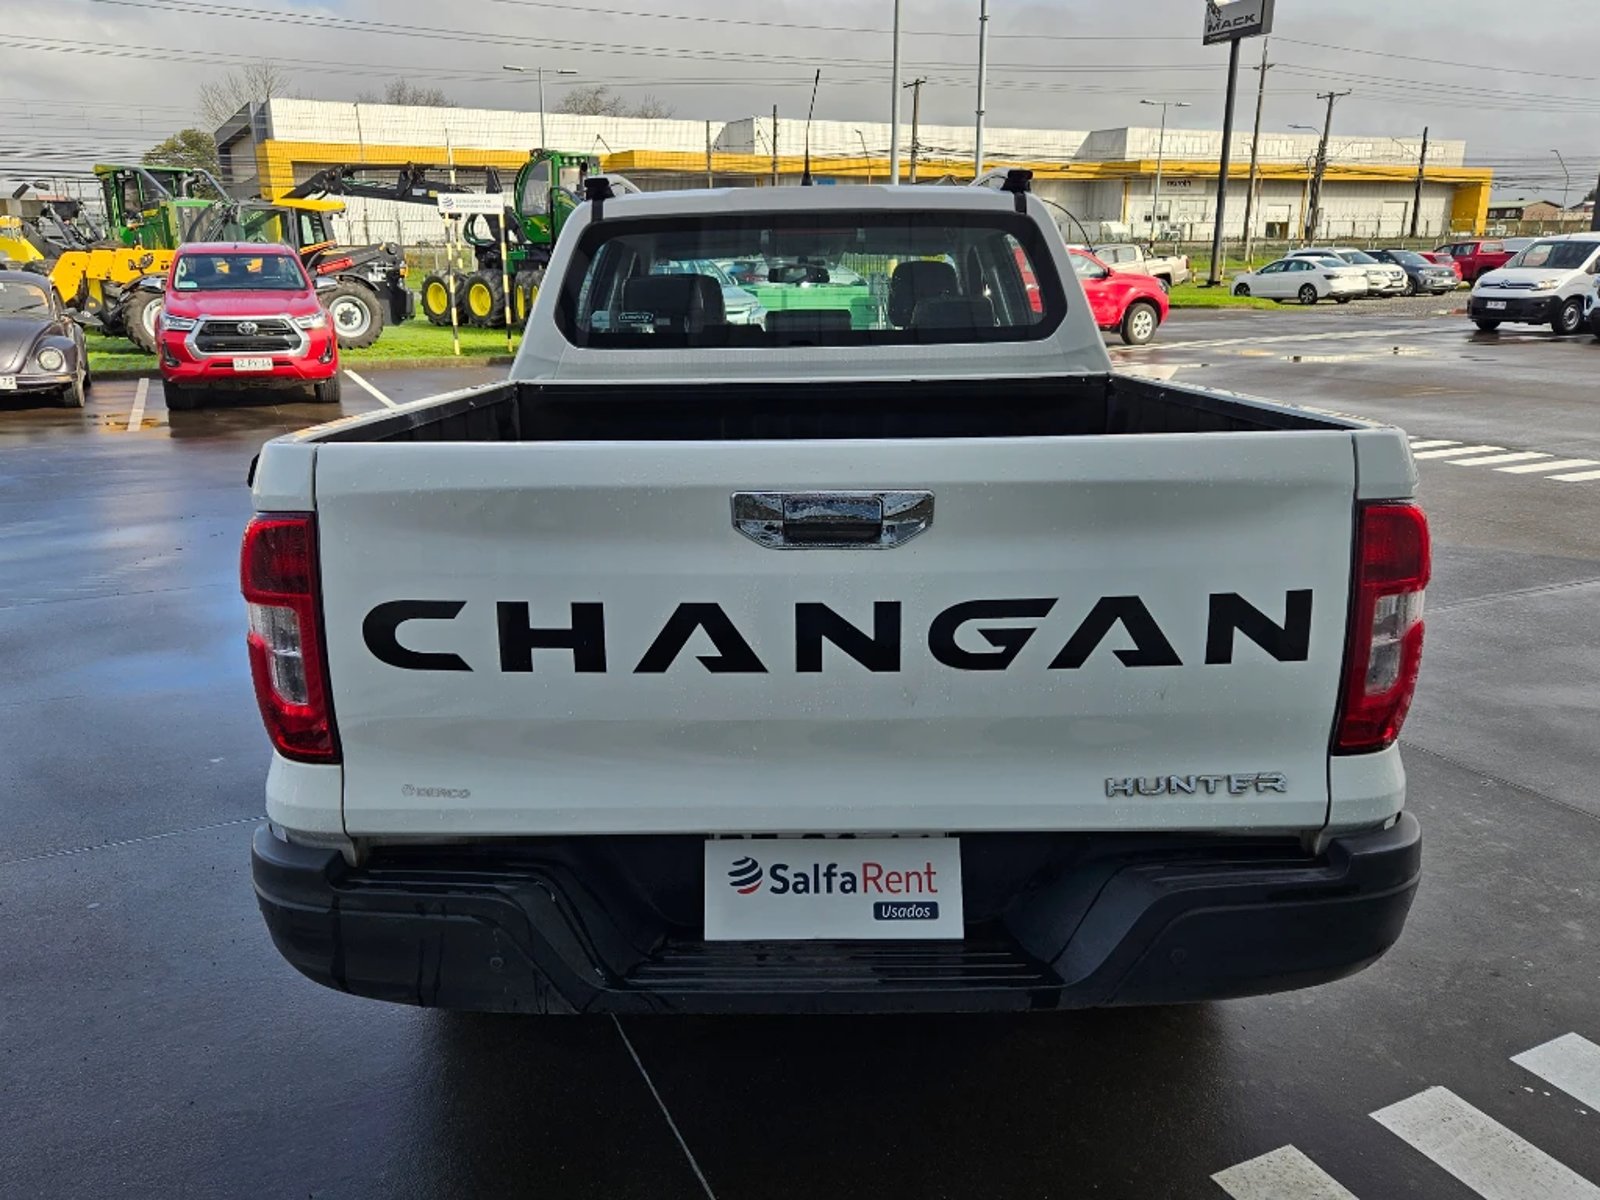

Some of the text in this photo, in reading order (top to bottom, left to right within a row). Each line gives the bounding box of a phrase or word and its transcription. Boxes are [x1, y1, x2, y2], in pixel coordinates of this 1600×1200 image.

[1207, 13, 1256, 33] MACK
[362, 588, 1312, 674] CHANGAN
[1105, 773, 1287, 798] HUNTER
[769, 861, 938, 895] SalfaRent
[881, 904, 931, 919] Usados
